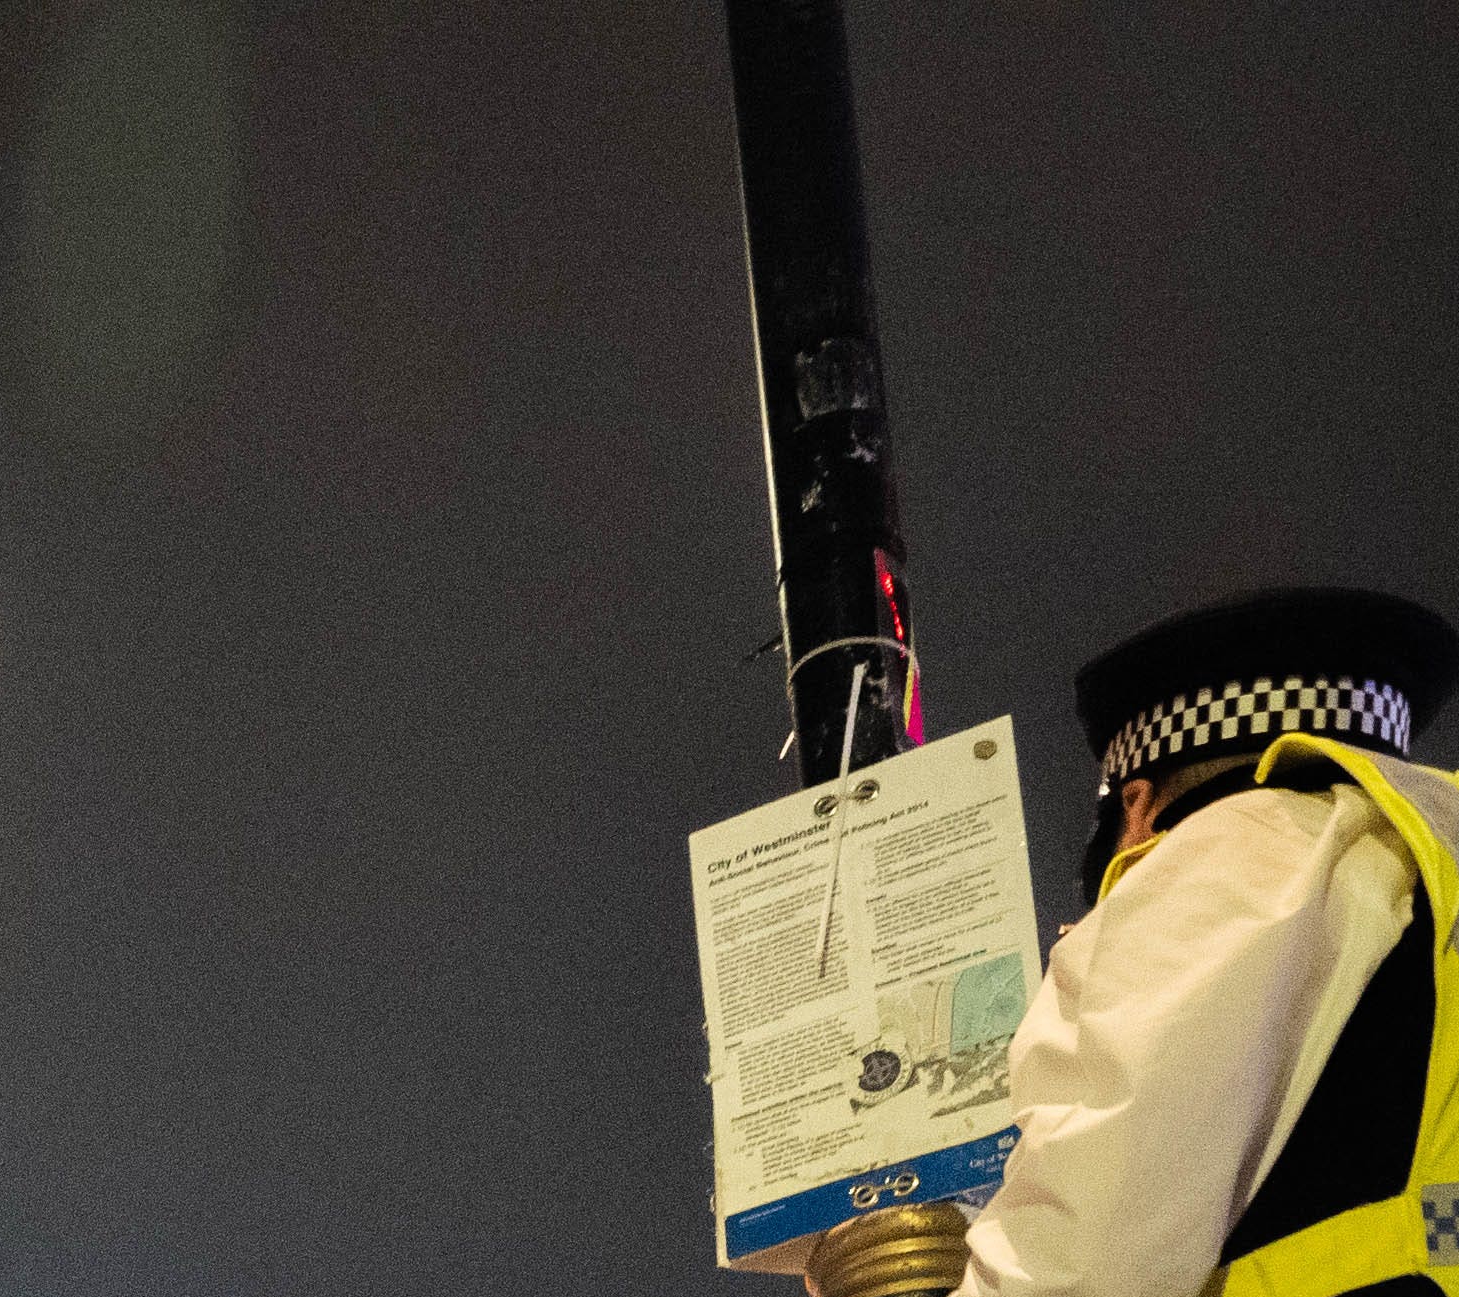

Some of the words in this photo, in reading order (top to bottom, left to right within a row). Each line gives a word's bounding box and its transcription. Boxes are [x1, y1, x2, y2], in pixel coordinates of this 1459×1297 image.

[707, 857, 732, 874] City
[735, 850, 748, 864] of
[752, 820, 832, 857] Westminster
